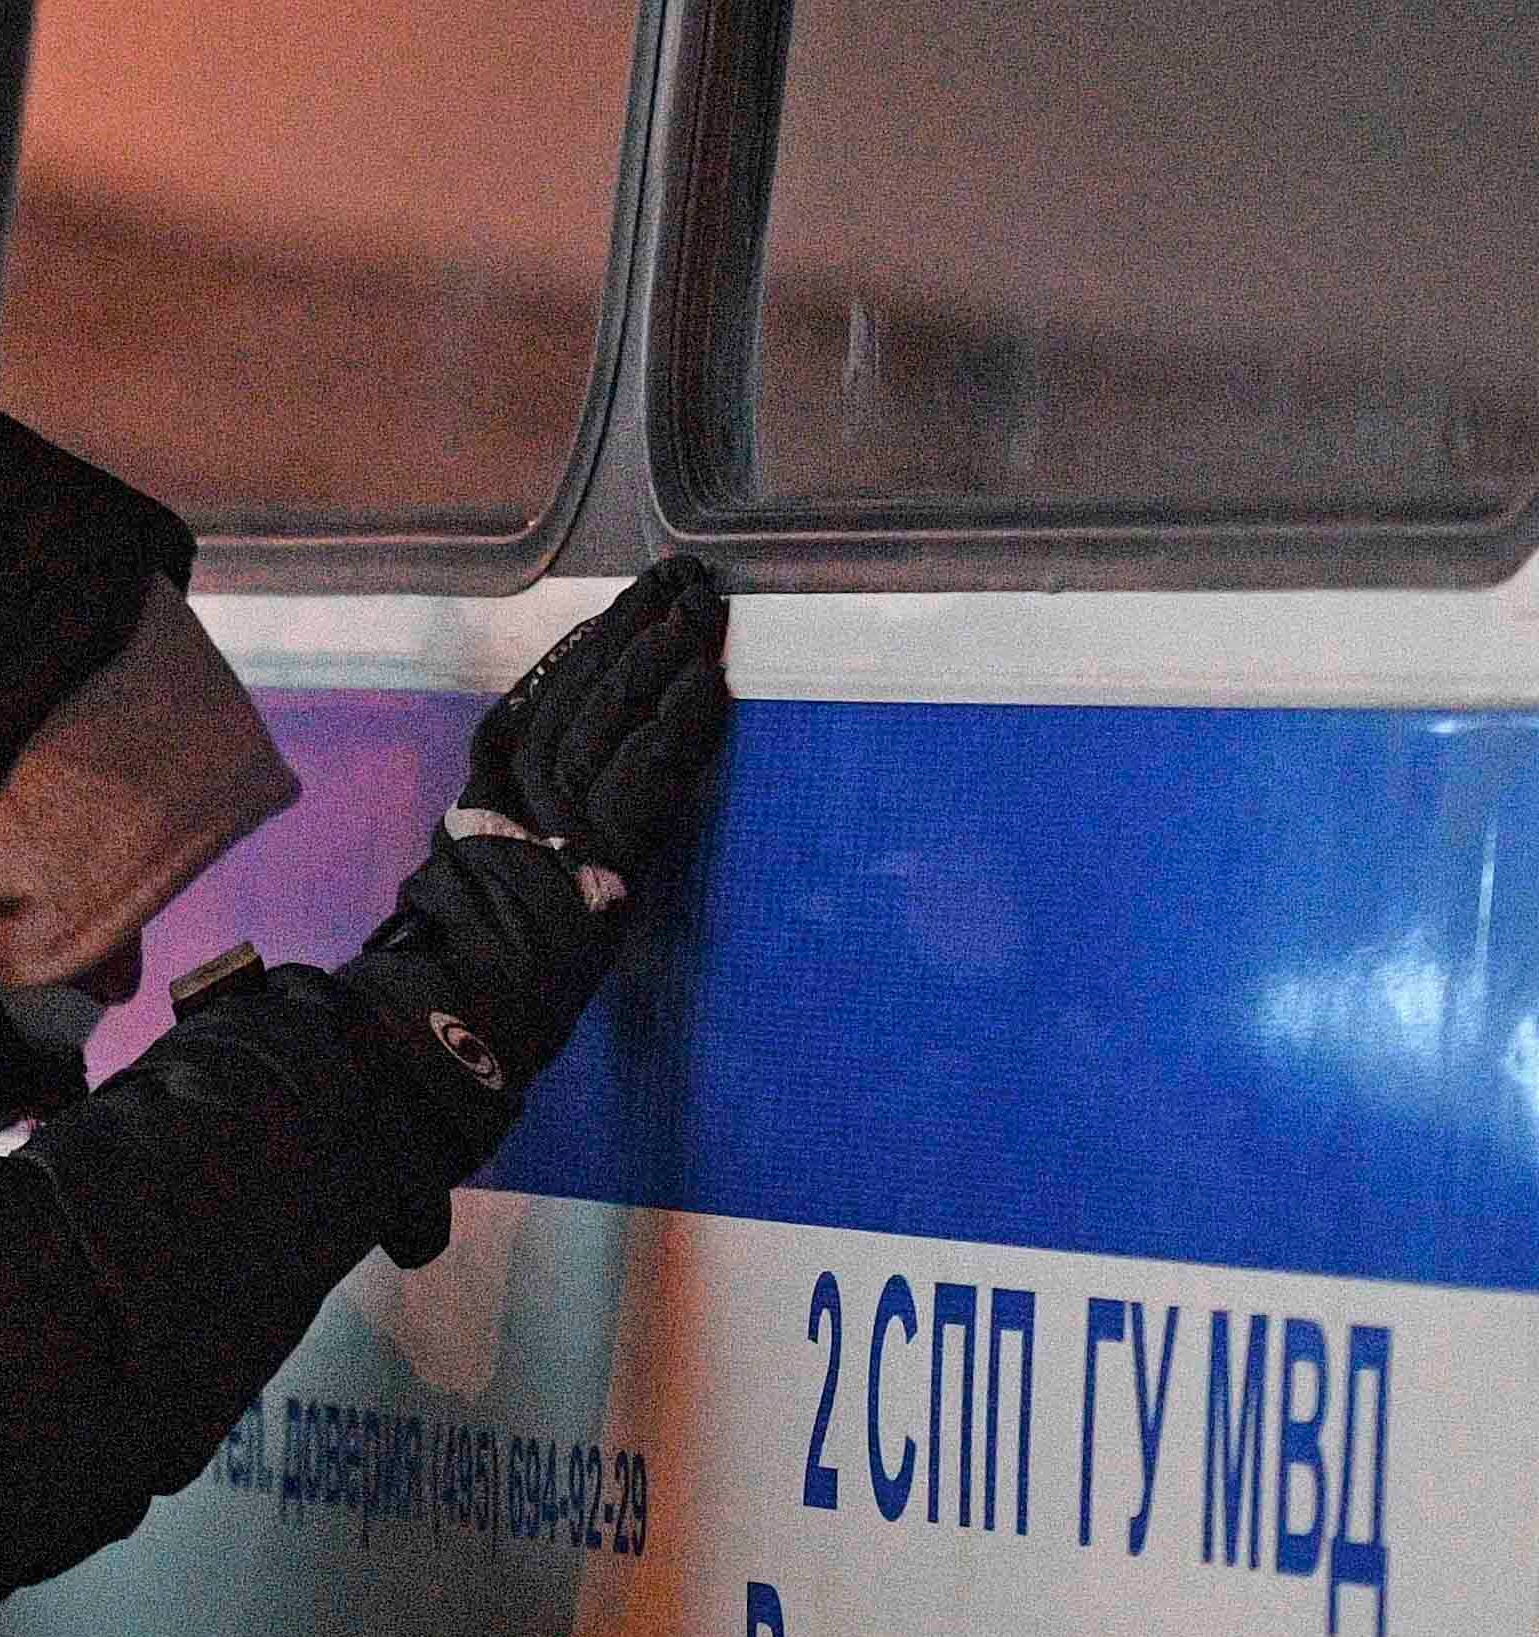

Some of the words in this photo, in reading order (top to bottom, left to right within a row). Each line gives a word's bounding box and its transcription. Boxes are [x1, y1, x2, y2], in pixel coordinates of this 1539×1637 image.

[280, 1396, 424, 1548] доверия
[431, 1422, 500, 1558] (495)
[506, 1436, 648, 1556] 694-92-29
[803, 1271, 843, 1511] 2
[867, 1274, 1037, 1536] СПП
[1077, 1297, 1180, 1556] ГУ
